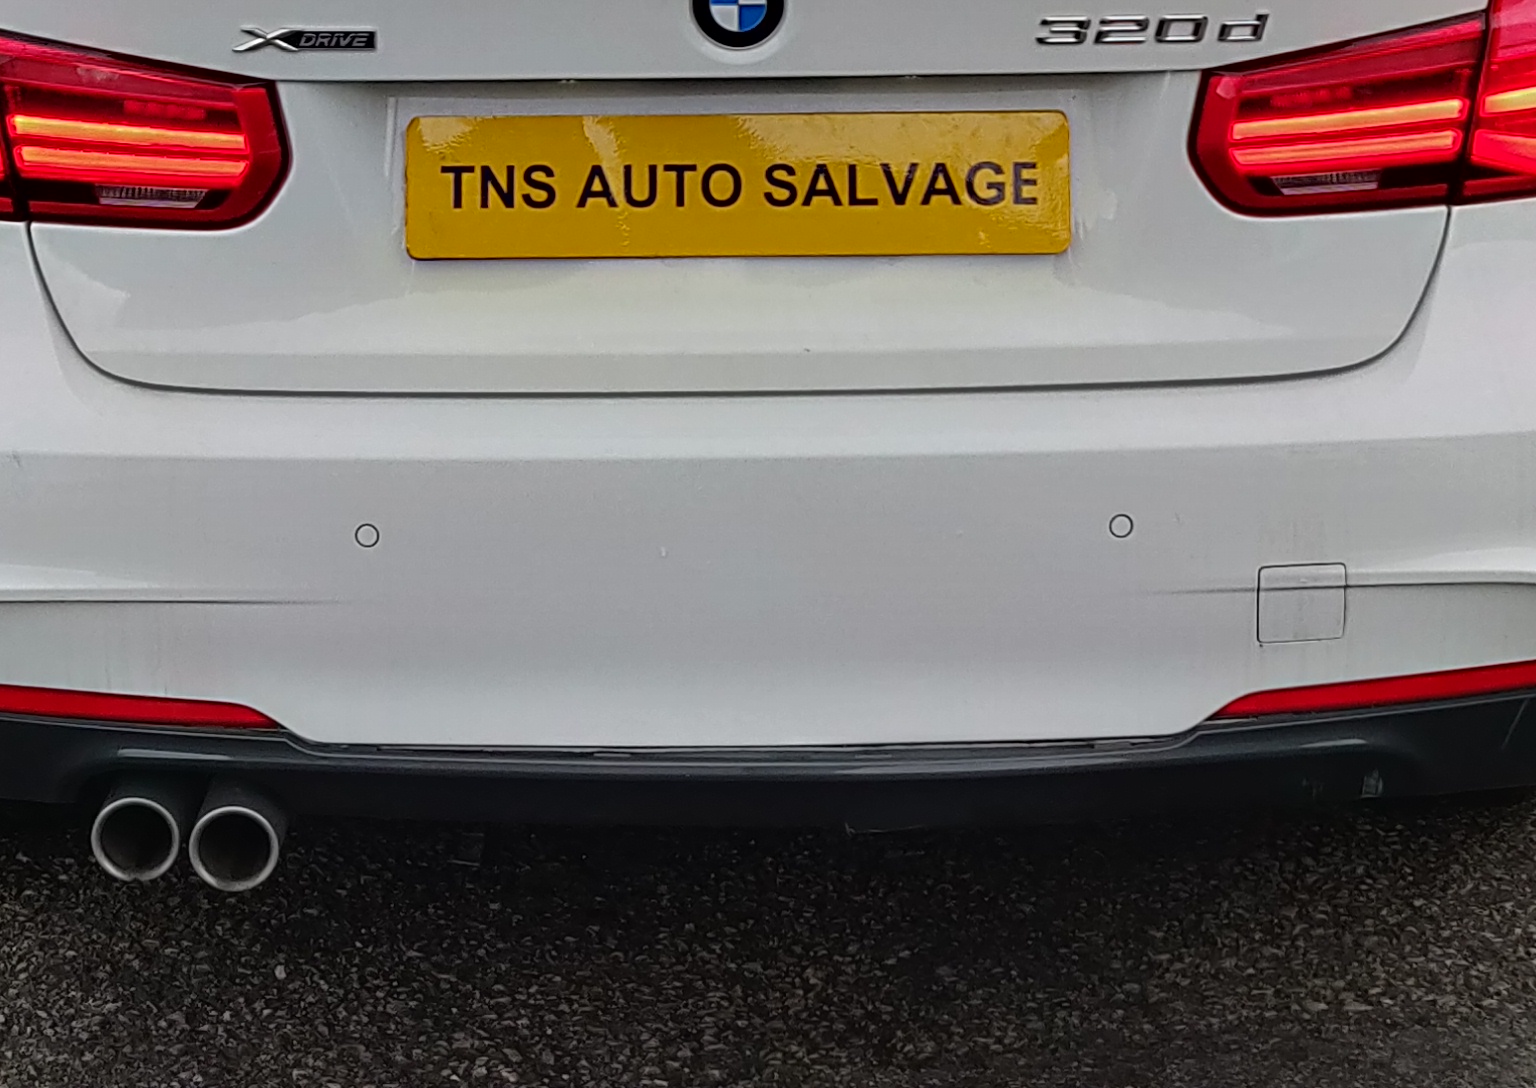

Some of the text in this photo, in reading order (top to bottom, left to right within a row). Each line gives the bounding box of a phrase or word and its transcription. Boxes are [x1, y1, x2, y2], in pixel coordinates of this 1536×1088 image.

[1035, 9, 1271, 45] 320d
[440, 159, 1039, 210] TNS AUTO SALVAGE
